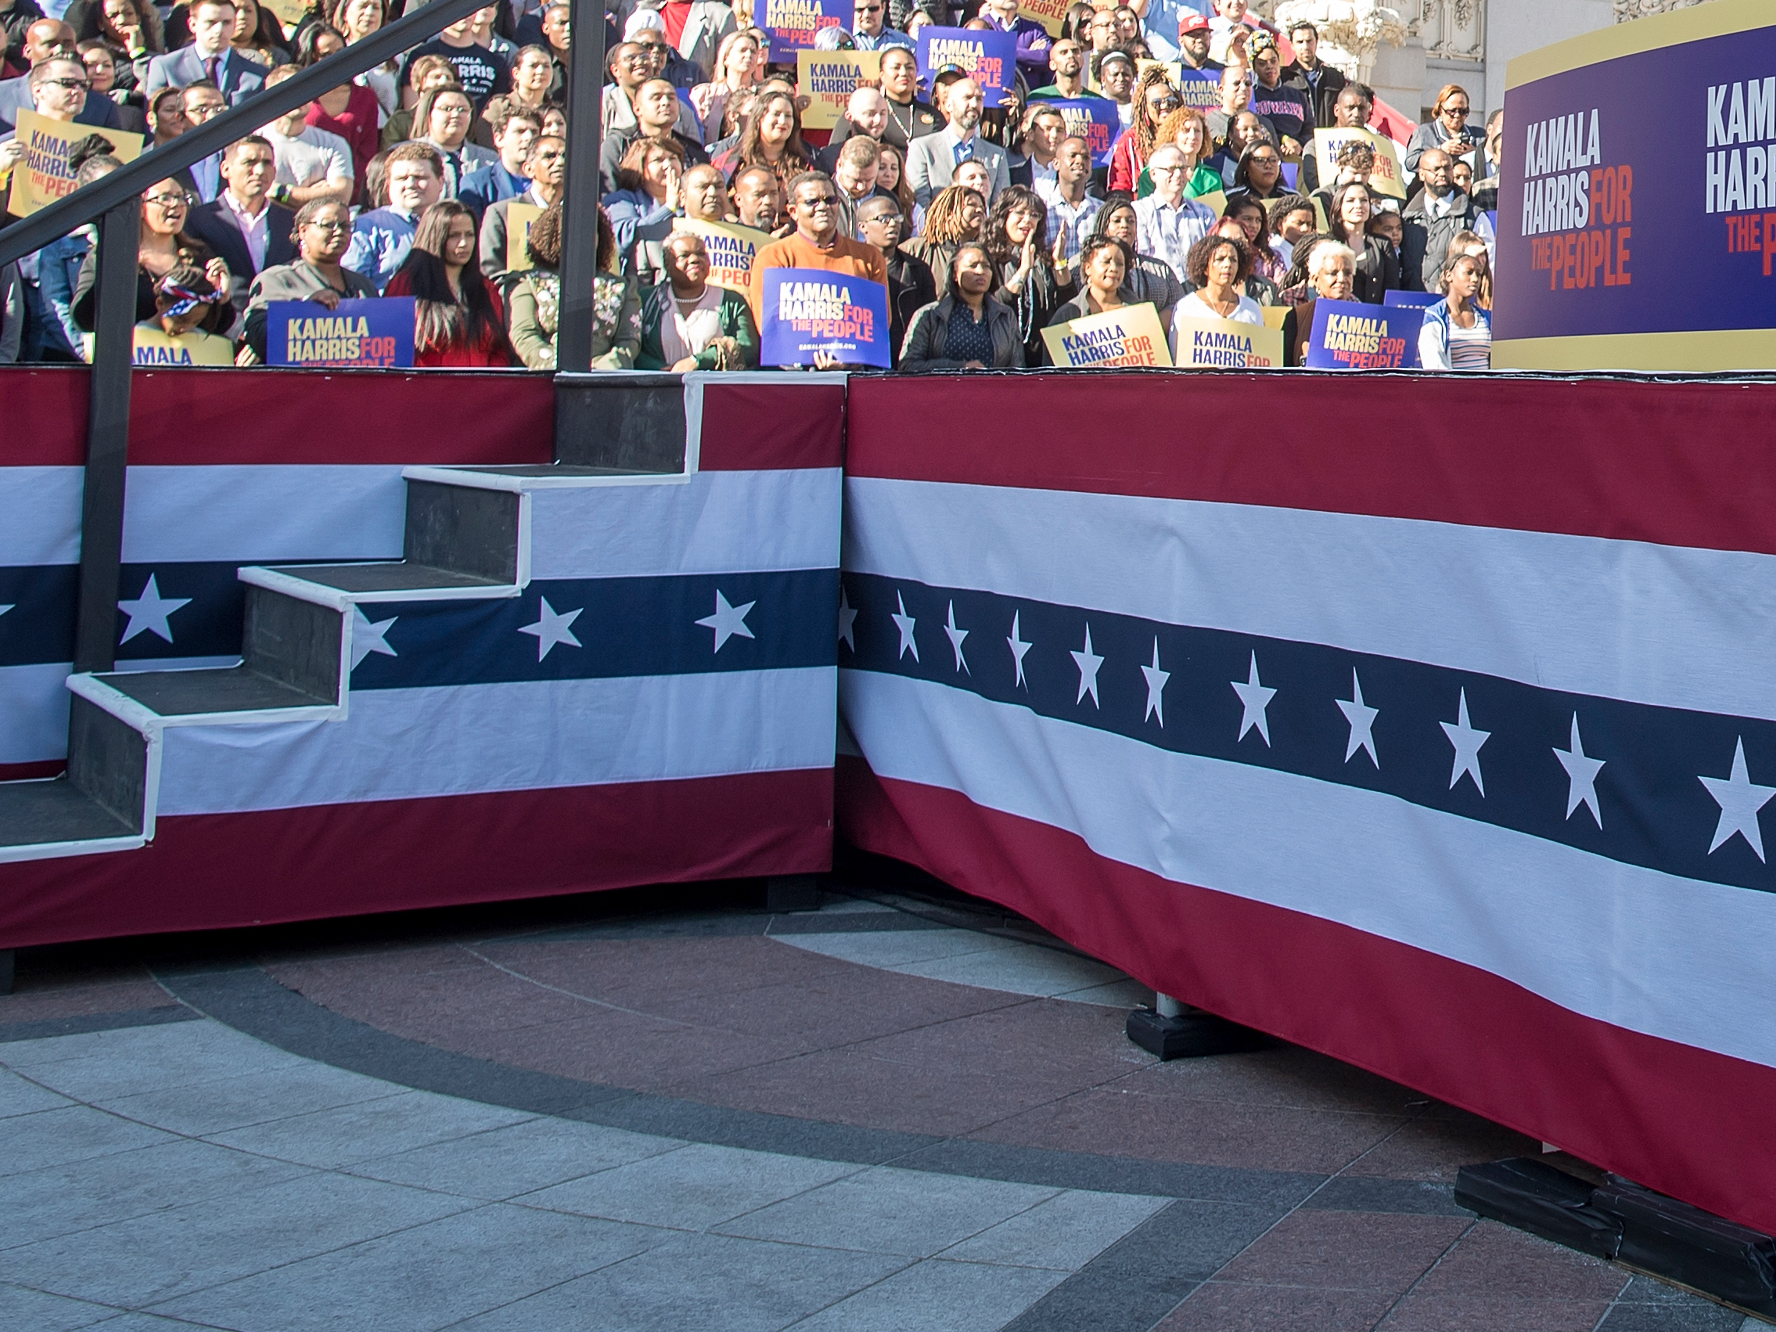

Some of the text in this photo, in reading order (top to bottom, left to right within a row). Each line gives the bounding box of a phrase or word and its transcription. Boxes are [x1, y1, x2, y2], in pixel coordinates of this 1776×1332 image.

[765, 12, 816, 31] HARRIS
[775, 28, 816, 45] THE PEO
[928, 37, 985, 57] KAMALA
[448, 56, 482, 65] AMALA
[977, 56, 1003, 72] FOR
[458, 64, 496, 80] RRIS
[810, 63, 862, 78] KAMALA
[966, 71, 1002, 87] OPLE
[811, 78, 857, 93] HARRIS
[1180, 80, 1219, 93] KAMAL
[821, 93, 835, 103] THE
[1060, 107, 1093, 123] MALA
[1065, 121, 1108, 139] RIS FOR
[31, 129, 73, 158] KAMA
[1085, 137, 1110, 152] PLE
[1524, 108, 1600, 179] KAMALA
[1373, 152, 1392, 168] FOR
[1371, 165, 1395, 180] PLE
[44, 176, 79, 198] PEO
[1522, 164, 1633, 237] HARRIS FOR
[1725, 214, 1761, 253] THE
[704, 235, 756, 257] AMALA
[713, 252, 750, 270] RRIS
[1531, 227, 1631, 291] THE PEOPLE
[722, 269, 751, 287] PEO
[779, 282, 851, 305] KAMALA
[779, 300, 874, 325] HARRIS FOR
[287, 316, 369, 339] KAMALA
[791, 319, 875, 342] THE PEOPLE
[1327, 313, 1388, 337] KAMALA
[1062, 325, 1126, 352] KAMALA
[1194, 331, 1252, 353] KAMALA
[1323, 331, 1406, 355] HARRIS FOR
[132, 347, 193, 365] MALA
[287, 336, 395, 362] HARRIS FOR
[1067, 335, 1153, 366] HARRIS FOR
[1192, 348, 1246, 367] HARRIS
[1333, 350, 1402, 368] THE PEOPLE
